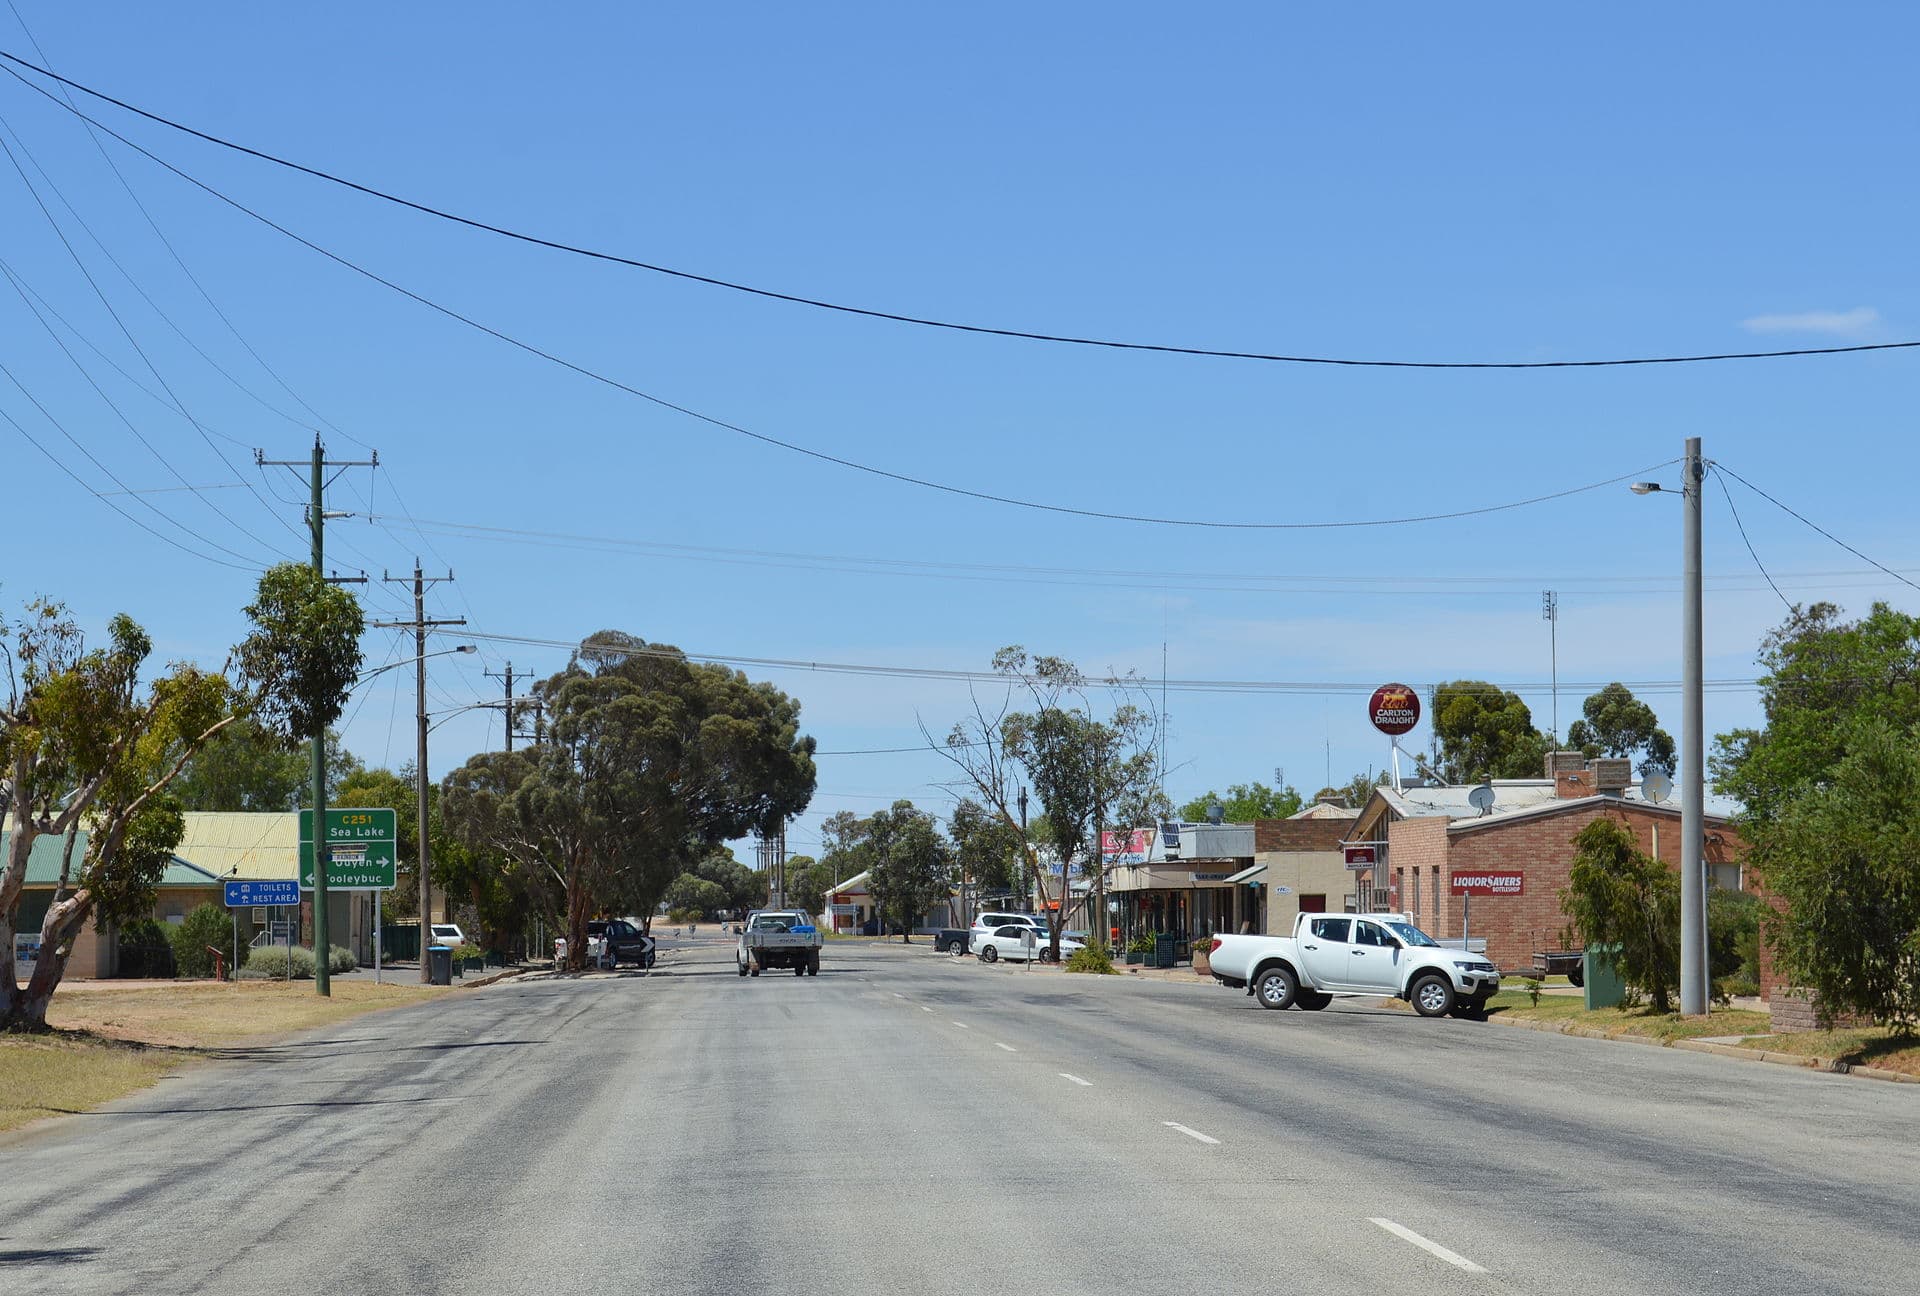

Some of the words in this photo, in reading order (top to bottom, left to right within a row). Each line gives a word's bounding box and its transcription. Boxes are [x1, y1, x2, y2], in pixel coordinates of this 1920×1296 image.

[1376, 709, 1414, 717] CARLTON
[1375, 716, 1415, 724] DRAUGHT
[342, 815, 372, 825] C251
[330, 828, 351, 837] Sea
[357, 827, 385, 837] Lake
[327, 873, 382, 885] ooleybuc
[259, 884, 291, 892] TOILETS
[275, 894, 297, 902] AREA
